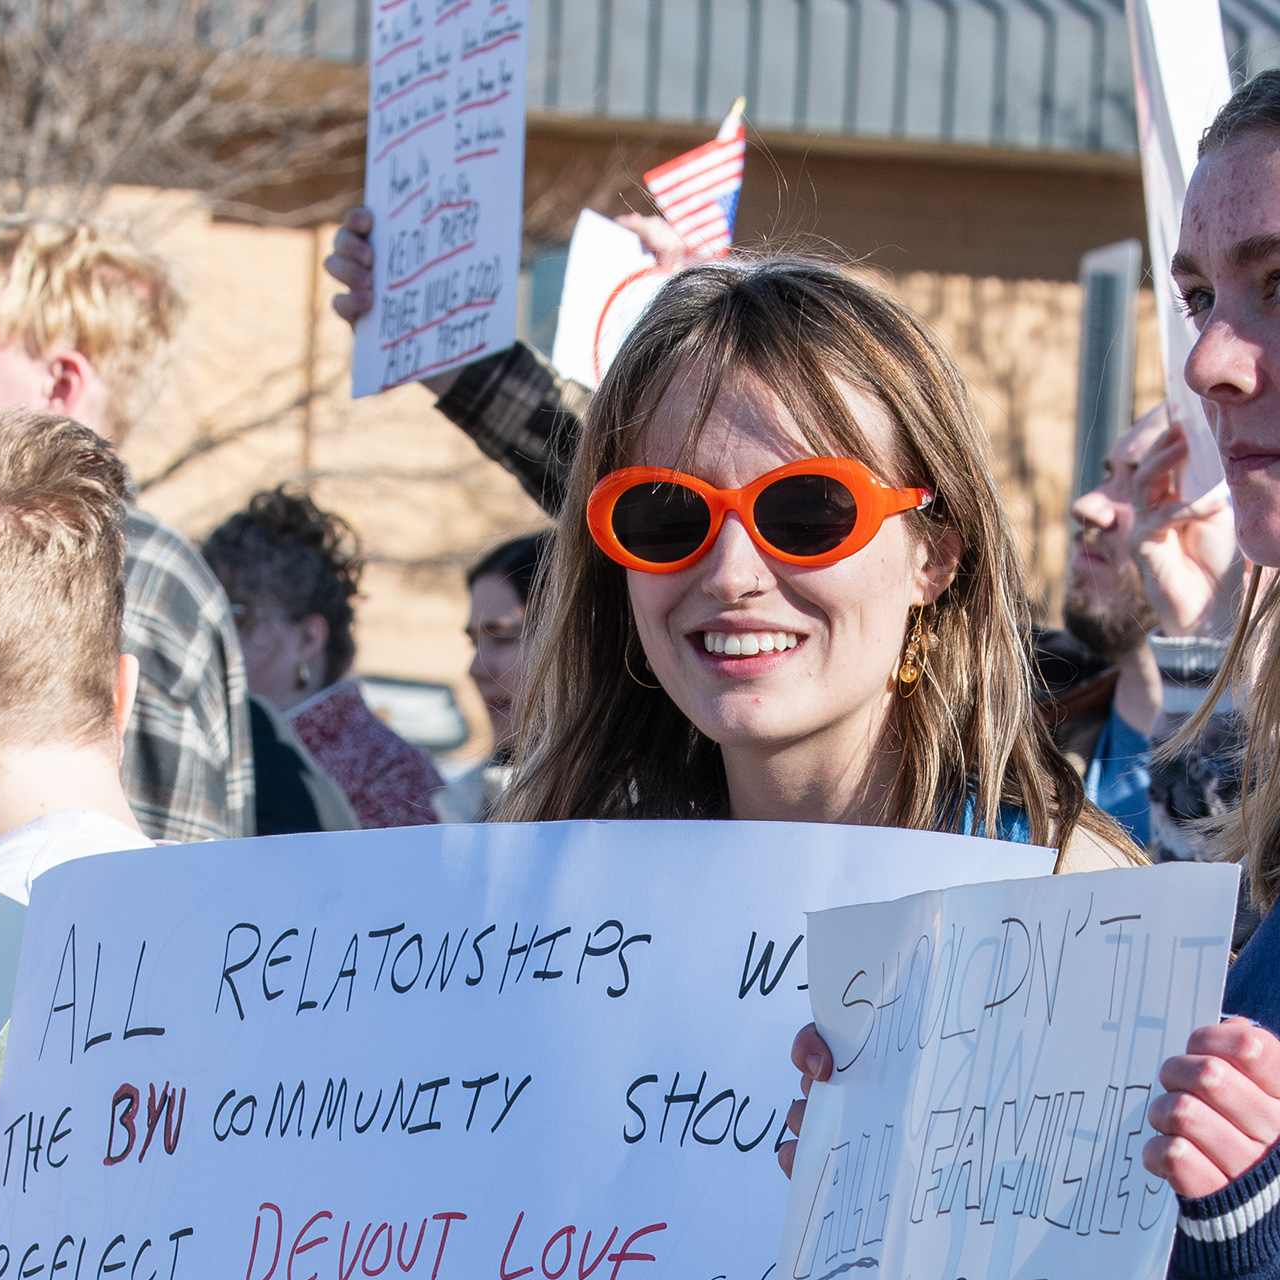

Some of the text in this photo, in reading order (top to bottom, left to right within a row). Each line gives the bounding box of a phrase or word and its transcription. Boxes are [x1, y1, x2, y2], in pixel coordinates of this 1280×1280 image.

[36, 922, 166, 1065] ALL
[214, 919, 652, 1021] RELATONSHIPS
[2, 1106, 73, 1194] THE
[102, 1080, 187, 1166] BYU
[213, 1071, 533, 1142] COMMUNITY
[793, 1122, 896, 1280] ALL
